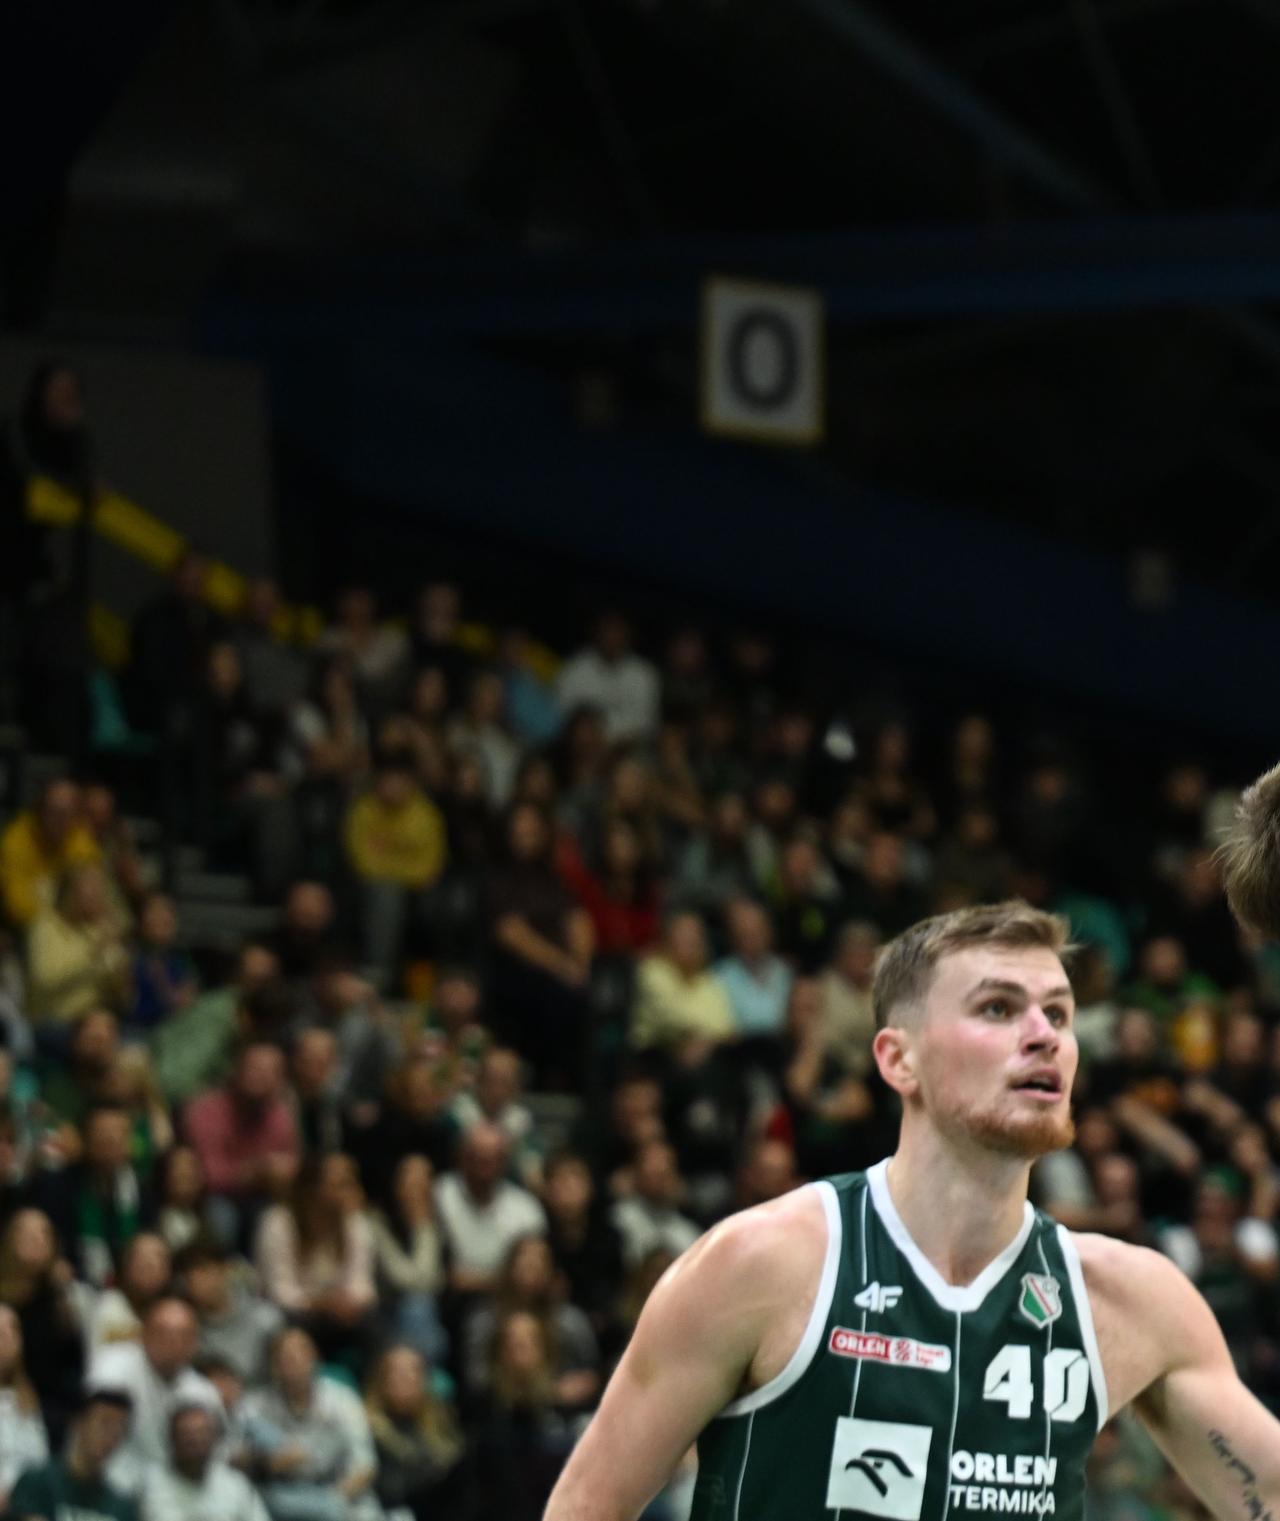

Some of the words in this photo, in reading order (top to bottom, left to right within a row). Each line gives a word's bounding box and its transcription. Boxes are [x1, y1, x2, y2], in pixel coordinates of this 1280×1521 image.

[854, 1280, 904, 1314] 4F
[834, 1333, 887, 1357] ORLEN
[982, 1343, 1090, 1423] 40
[951, 1449, 1058, 1486] ORLEN
[950, 1483, 1056, 1515] TERMIKA
